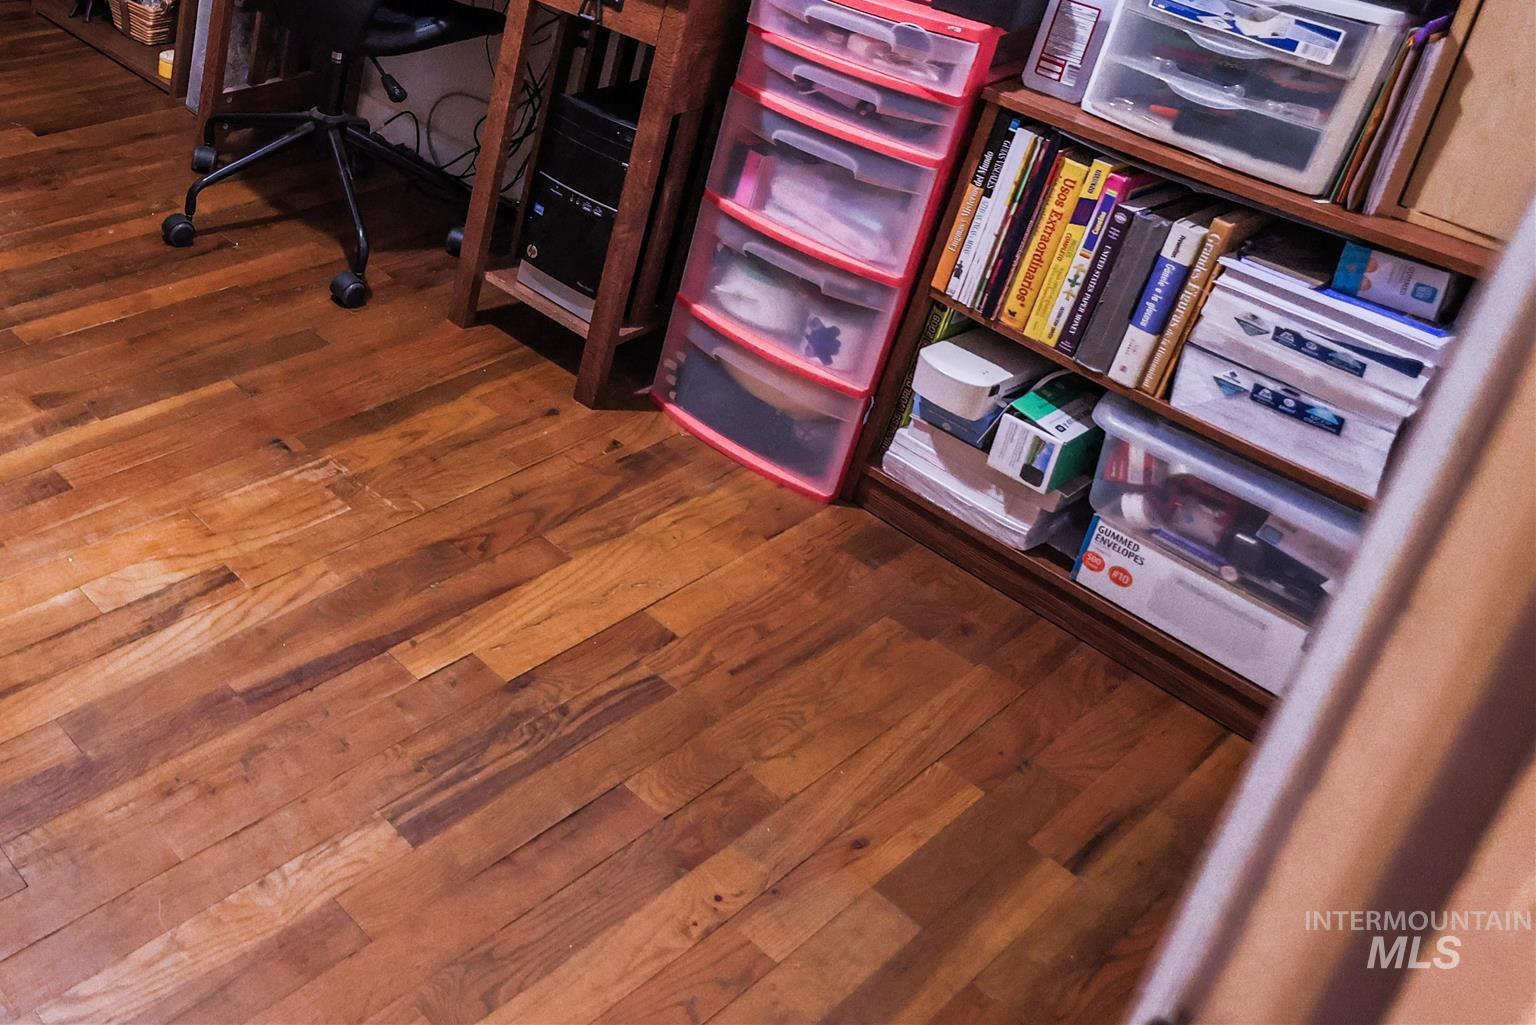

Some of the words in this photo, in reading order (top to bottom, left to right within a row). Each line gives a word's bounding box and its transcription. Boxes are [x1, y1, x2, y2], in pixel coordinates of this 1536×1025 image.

[977, 151, 994, 175] Mundo
[974, 174, 984, 187] del
[1054, 178, 1077, 208] Usos
[1056, 232, 1072, 262] COMPLETO
[1095, 244, 1111, 269] UNITED
[1191, 233, 1221, 281] Grandes
[1085, 269, 1100, 292] STATES
[1077, 292, 1090, 312] PAPER
[1150, 292, 1162, 303] la
[1168, 280, 1200, 330] Figuras
[1067, 313, 1082, 334] MONEY
[1136, 300, 1158, 328] glucosa
[1142, 346, 1167, 388] Humanidad
[1094, 533, 1145, 566] ENVELOPES
[1098, 525, 1140, 552] GUMMED
[1087, 553, 1102, 564] 500
[1112, 570, 1129, 584] #10
